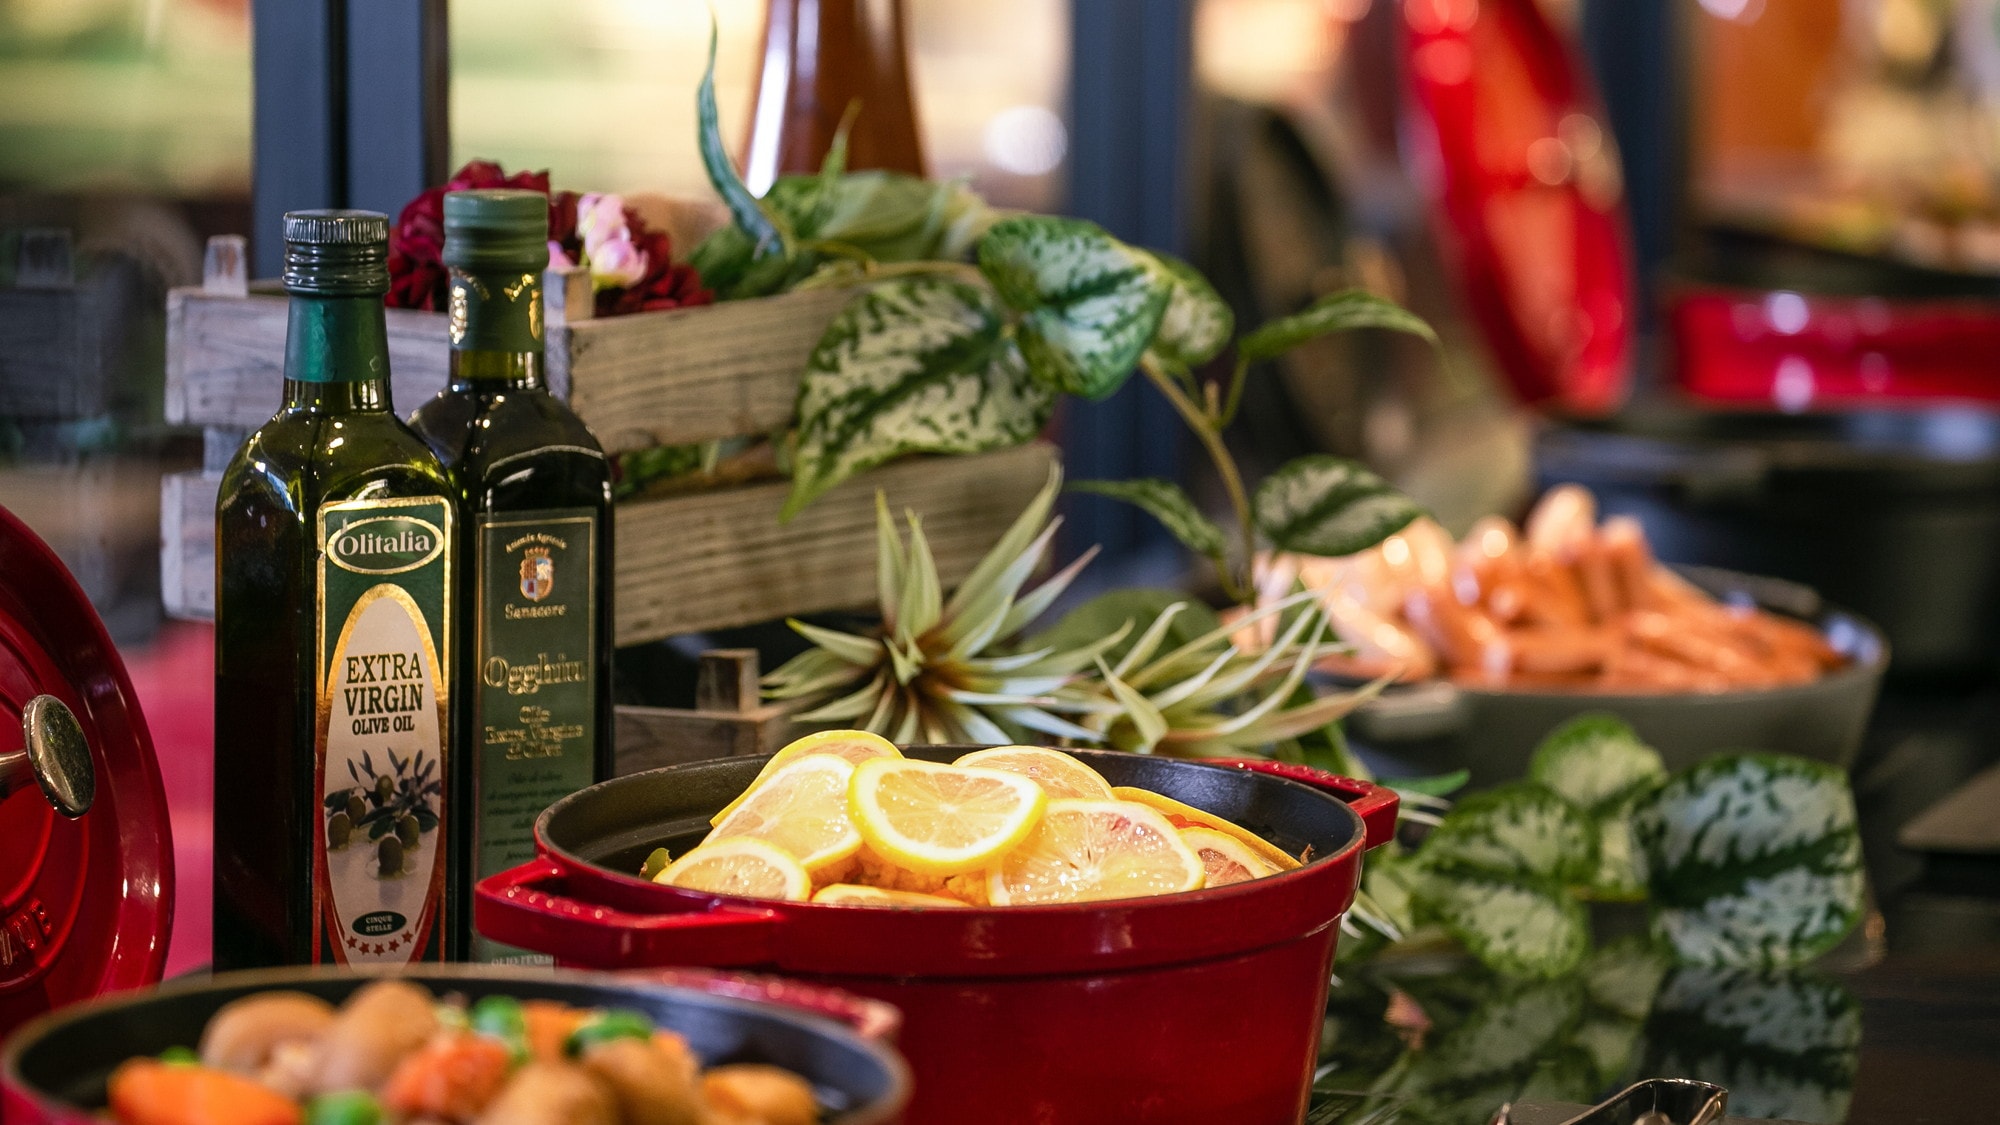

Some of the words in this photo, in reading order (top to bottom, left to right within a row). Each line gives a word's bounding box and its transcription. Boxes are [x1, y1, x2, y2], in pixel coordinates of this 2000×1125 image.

[337, 531, 431, 556] Olitalia
[346, 652, 423, 684] EXTRA
[344, 683, 424, 716] VIRGIN
[352, 716, 390, 736] OLIVE
[393, 715, 415, 732] OIL
[365, 914, 393, 925] CINQUE
[365, 923, 393, 933] STELLE
